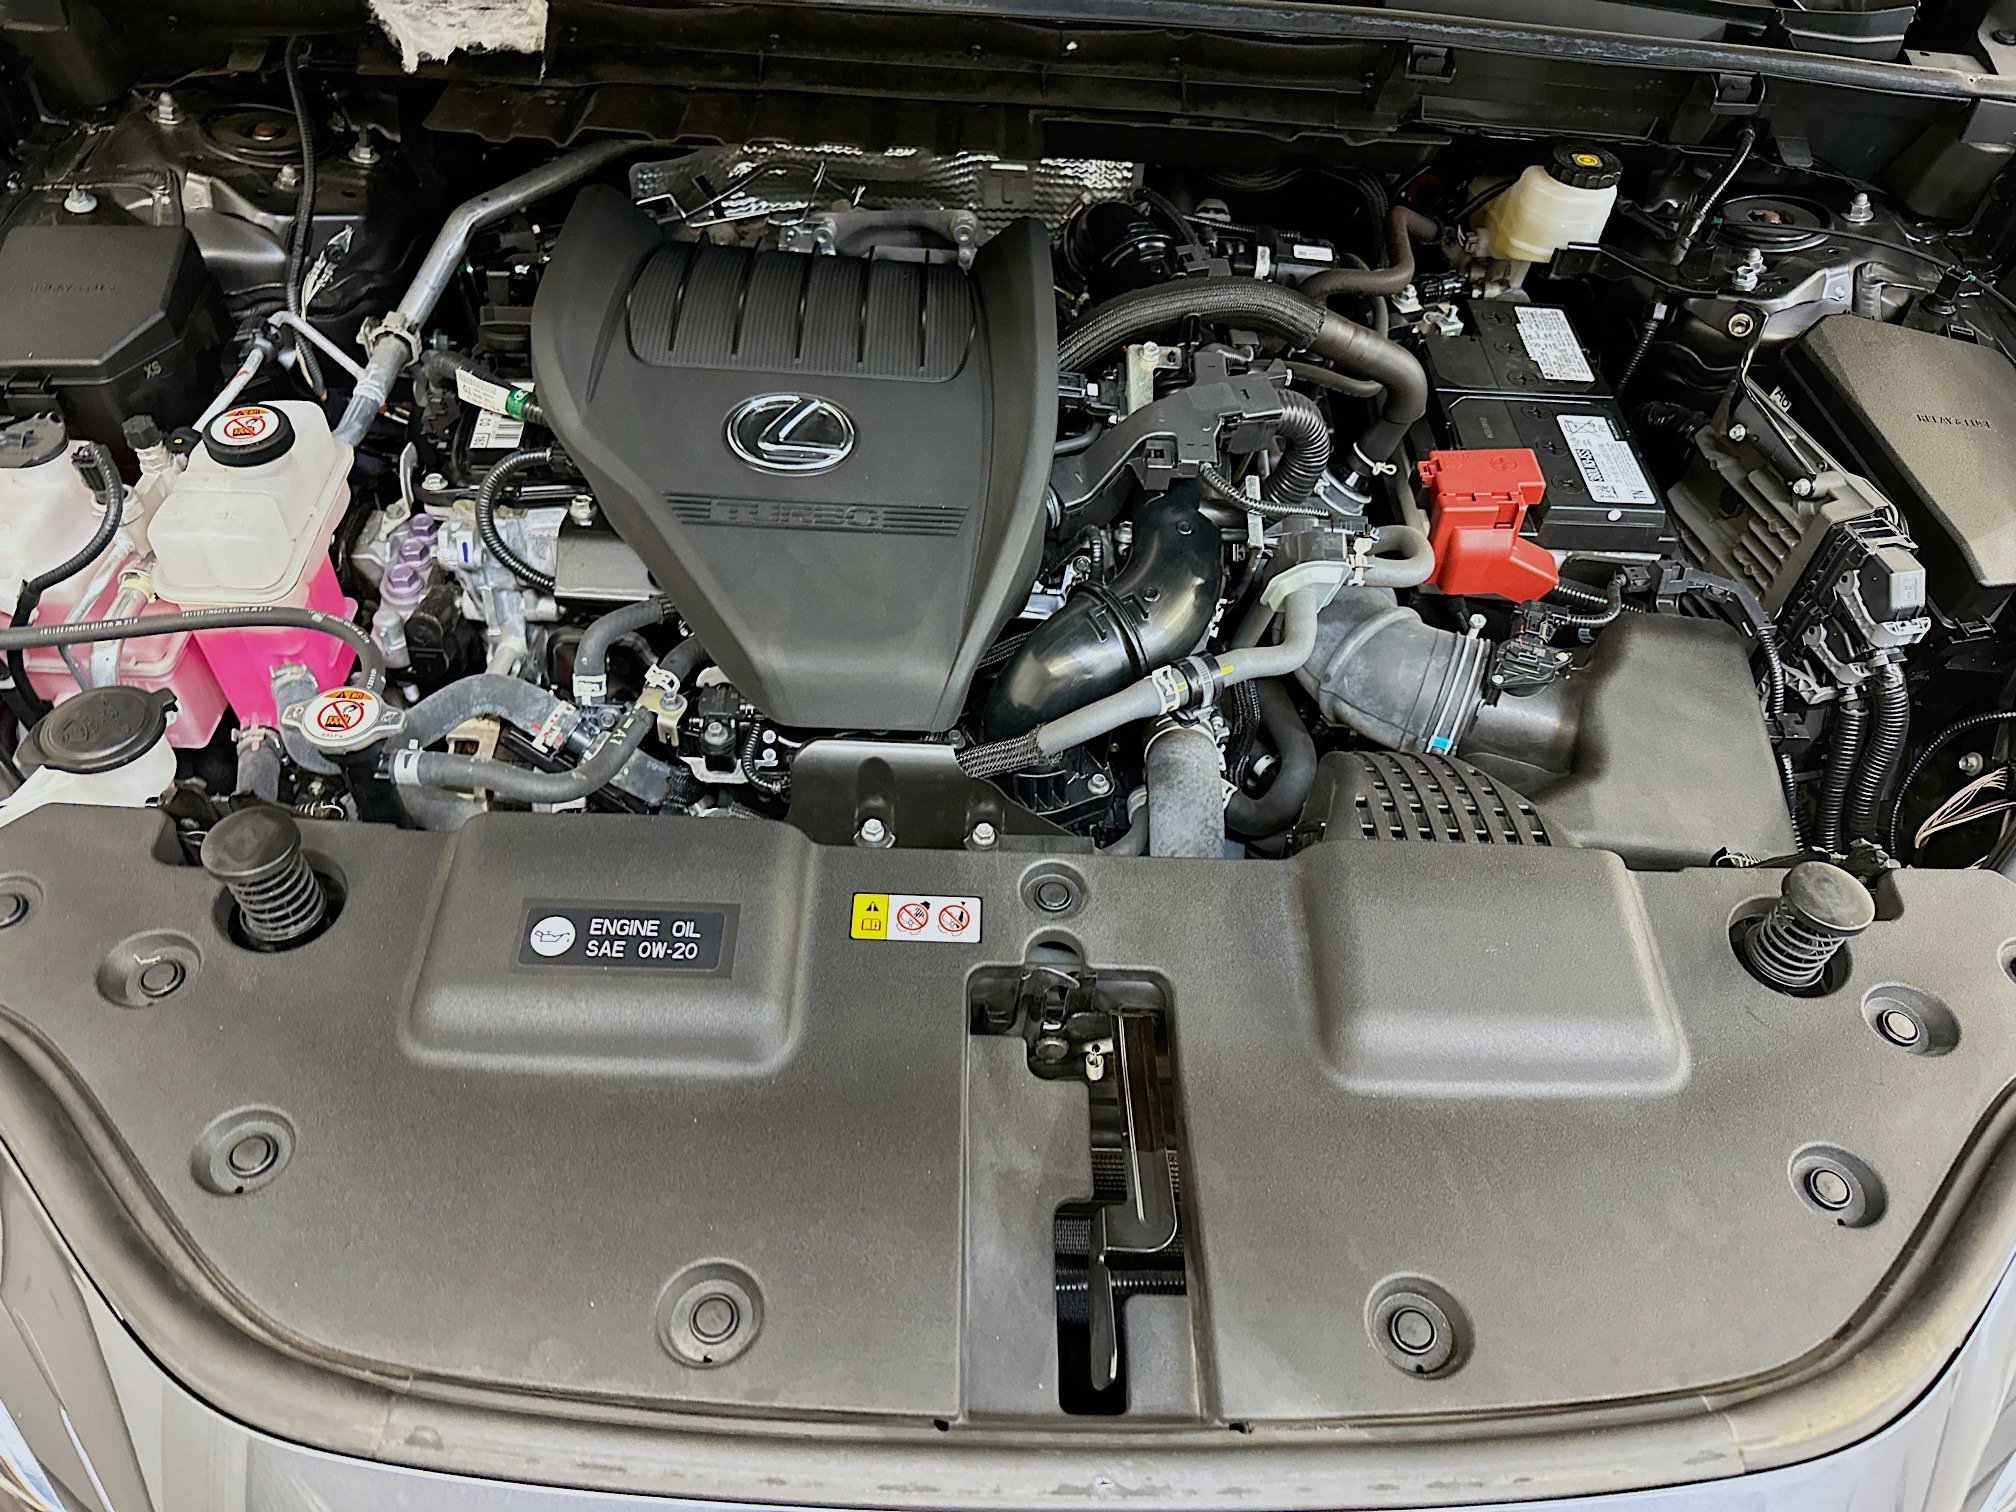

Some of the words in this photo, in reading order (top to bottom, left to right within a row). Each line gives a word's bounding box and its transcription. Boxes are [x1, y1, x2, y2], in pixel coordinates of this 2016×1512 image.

[713, 500, 881, 528] TURBO
[589, 918, 661, 937] ENGINE
[671, 920, 702, 939] OIL
[585, 940, 627, 958] SAE
[638, 941, 699, 960] 0W-20
